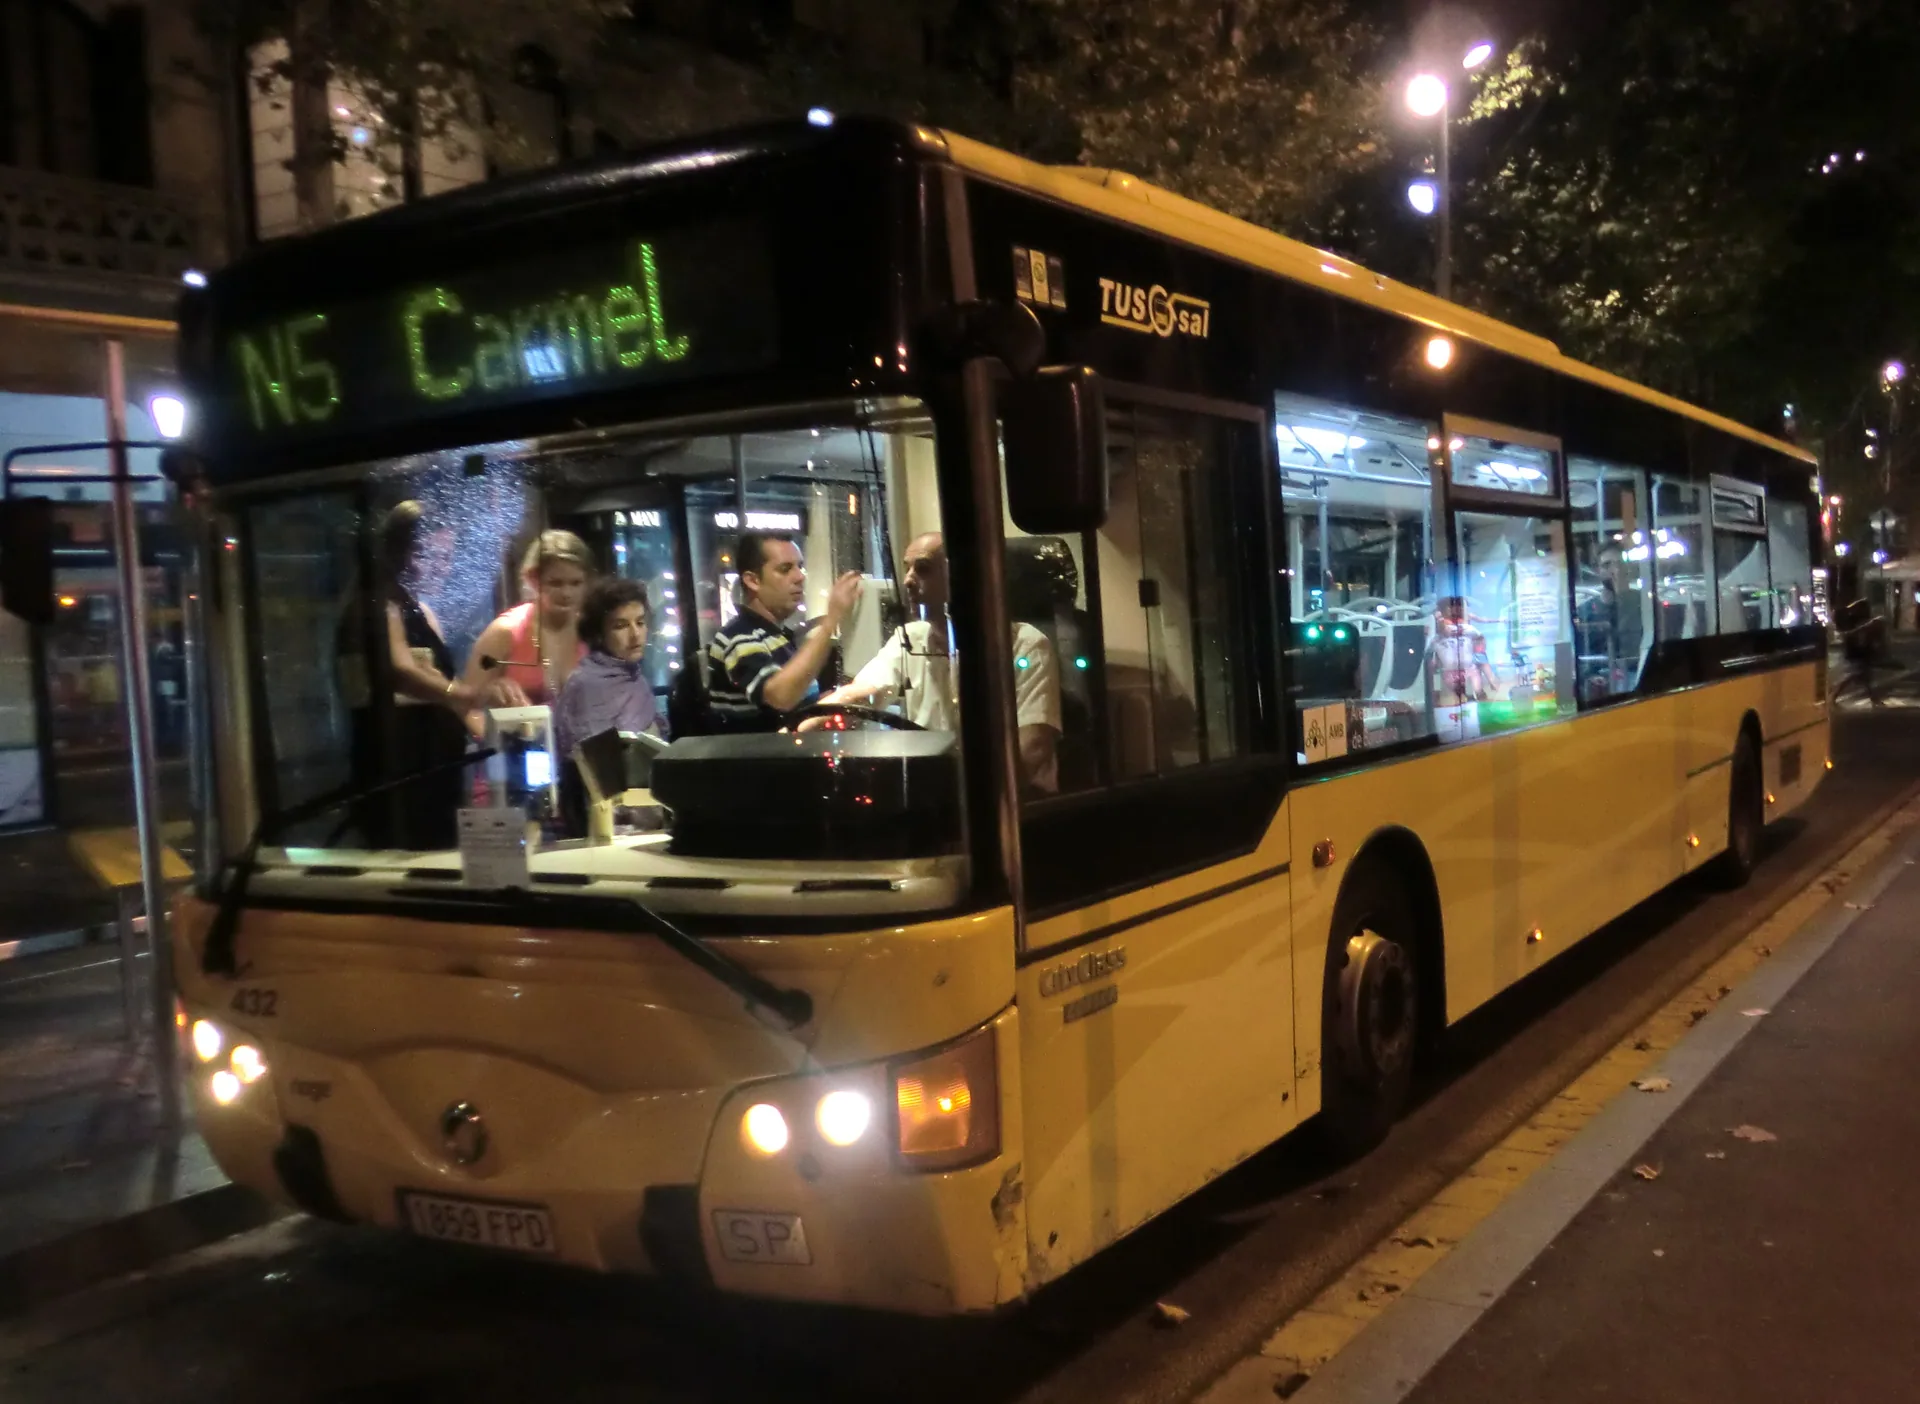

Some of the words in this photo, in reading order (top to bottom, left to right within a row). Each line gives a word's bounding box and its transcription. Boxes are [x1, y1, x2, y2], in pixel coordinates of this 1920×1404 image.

[238, 313, 339, 430] N5
[403, 243, 690, 400] Carmel
[1328, 723, 1344, 740] AMB
[229, 988, 278, 1017] 432
[730, 1219, 791, 1257] SP
